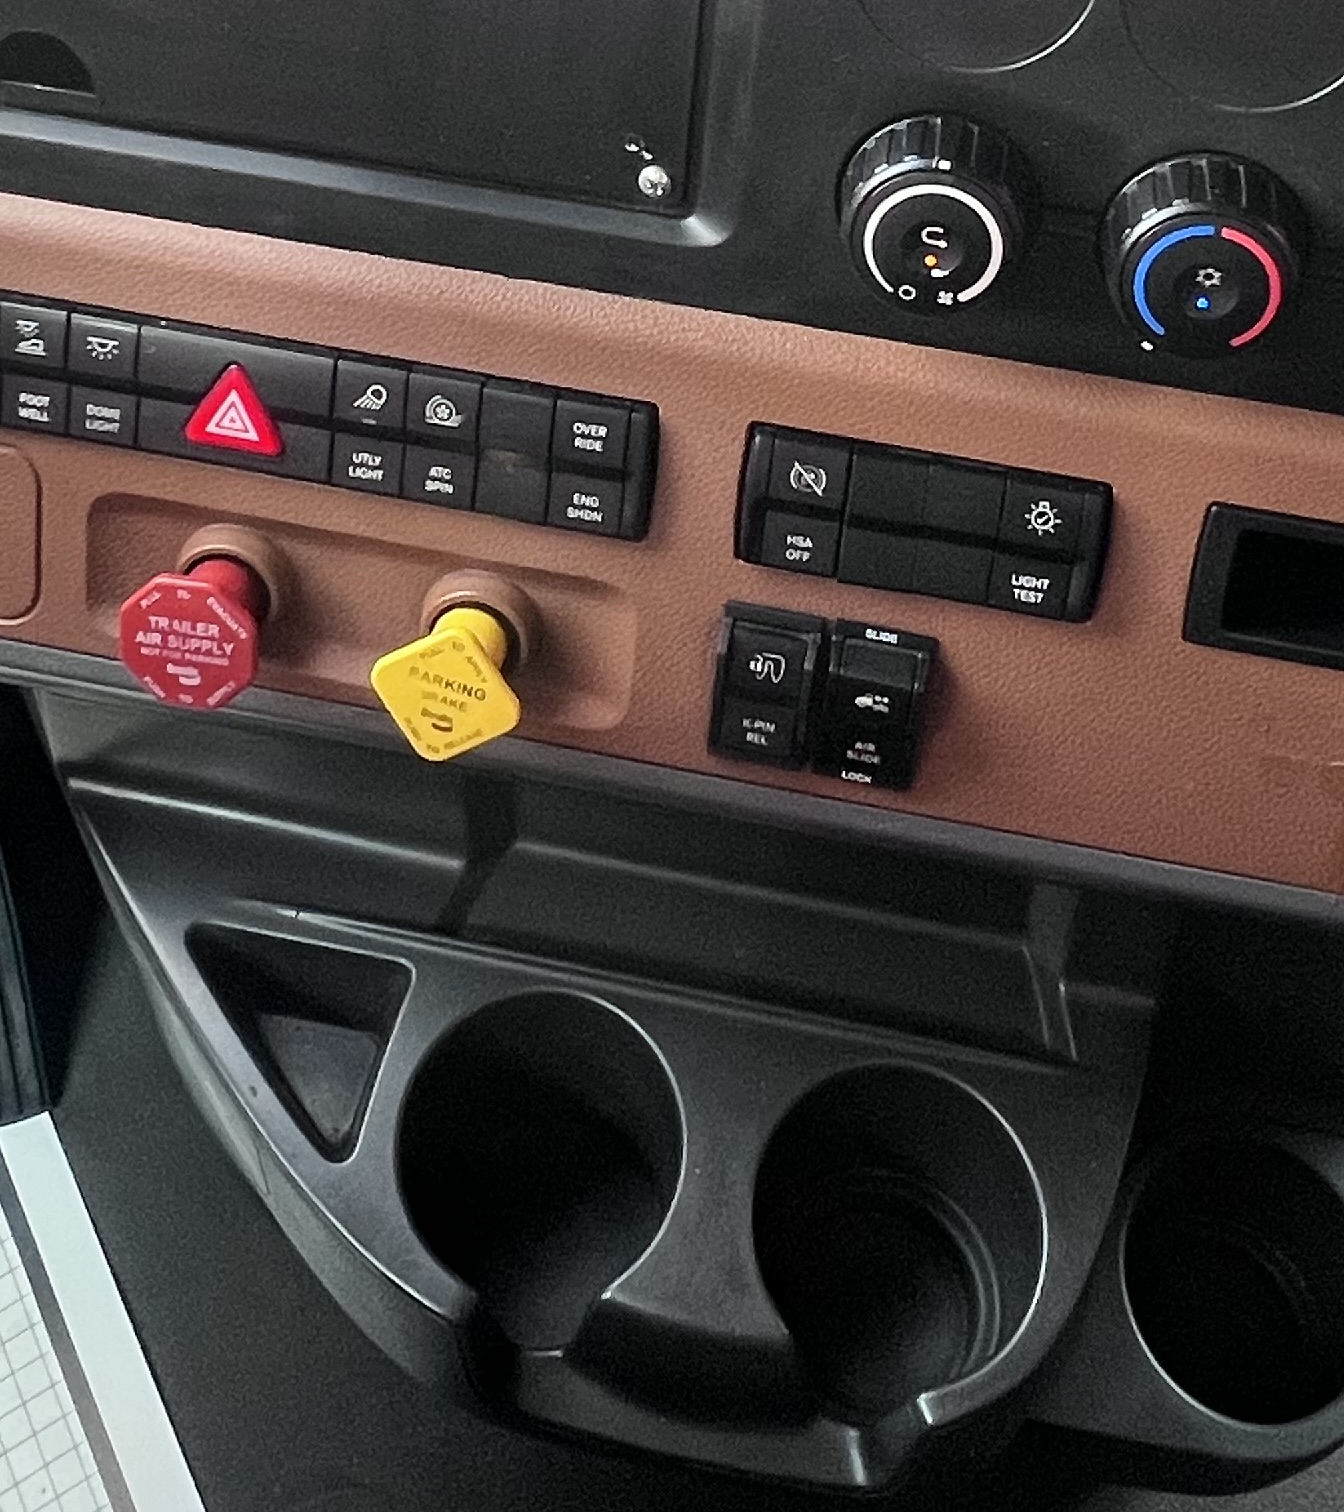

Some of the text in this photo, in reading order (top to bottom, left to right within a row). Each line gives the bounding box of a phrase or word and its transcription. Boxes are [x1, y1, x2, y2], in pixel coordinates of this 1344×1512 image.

[18, 392, 51, 407] FOOT
[572, 422, 607, 438] OVER
[574, 436, 604, 452] RIDE
[352, 452, 382, 467] UTLY
[348, 466, 384, 482] LIGHT
[428, 466, 452, 480] ATC
[573, 493, 600, 508] ENG
[786, 534, 813, 548] HSA
[785, 548, 811, 562] OFF
[1011, 573, 1050, 590] LIGHT
[1013, 588, 1044, 604] TEST
[148, 615, 220, 639] TRAILER
[135, 631, 234, 656] AIR SUPPLY
[408, 665, 487, 701] PARKING
[421, 690, 468, 713] AKE
[841, 770, 872, 784] LOCK
